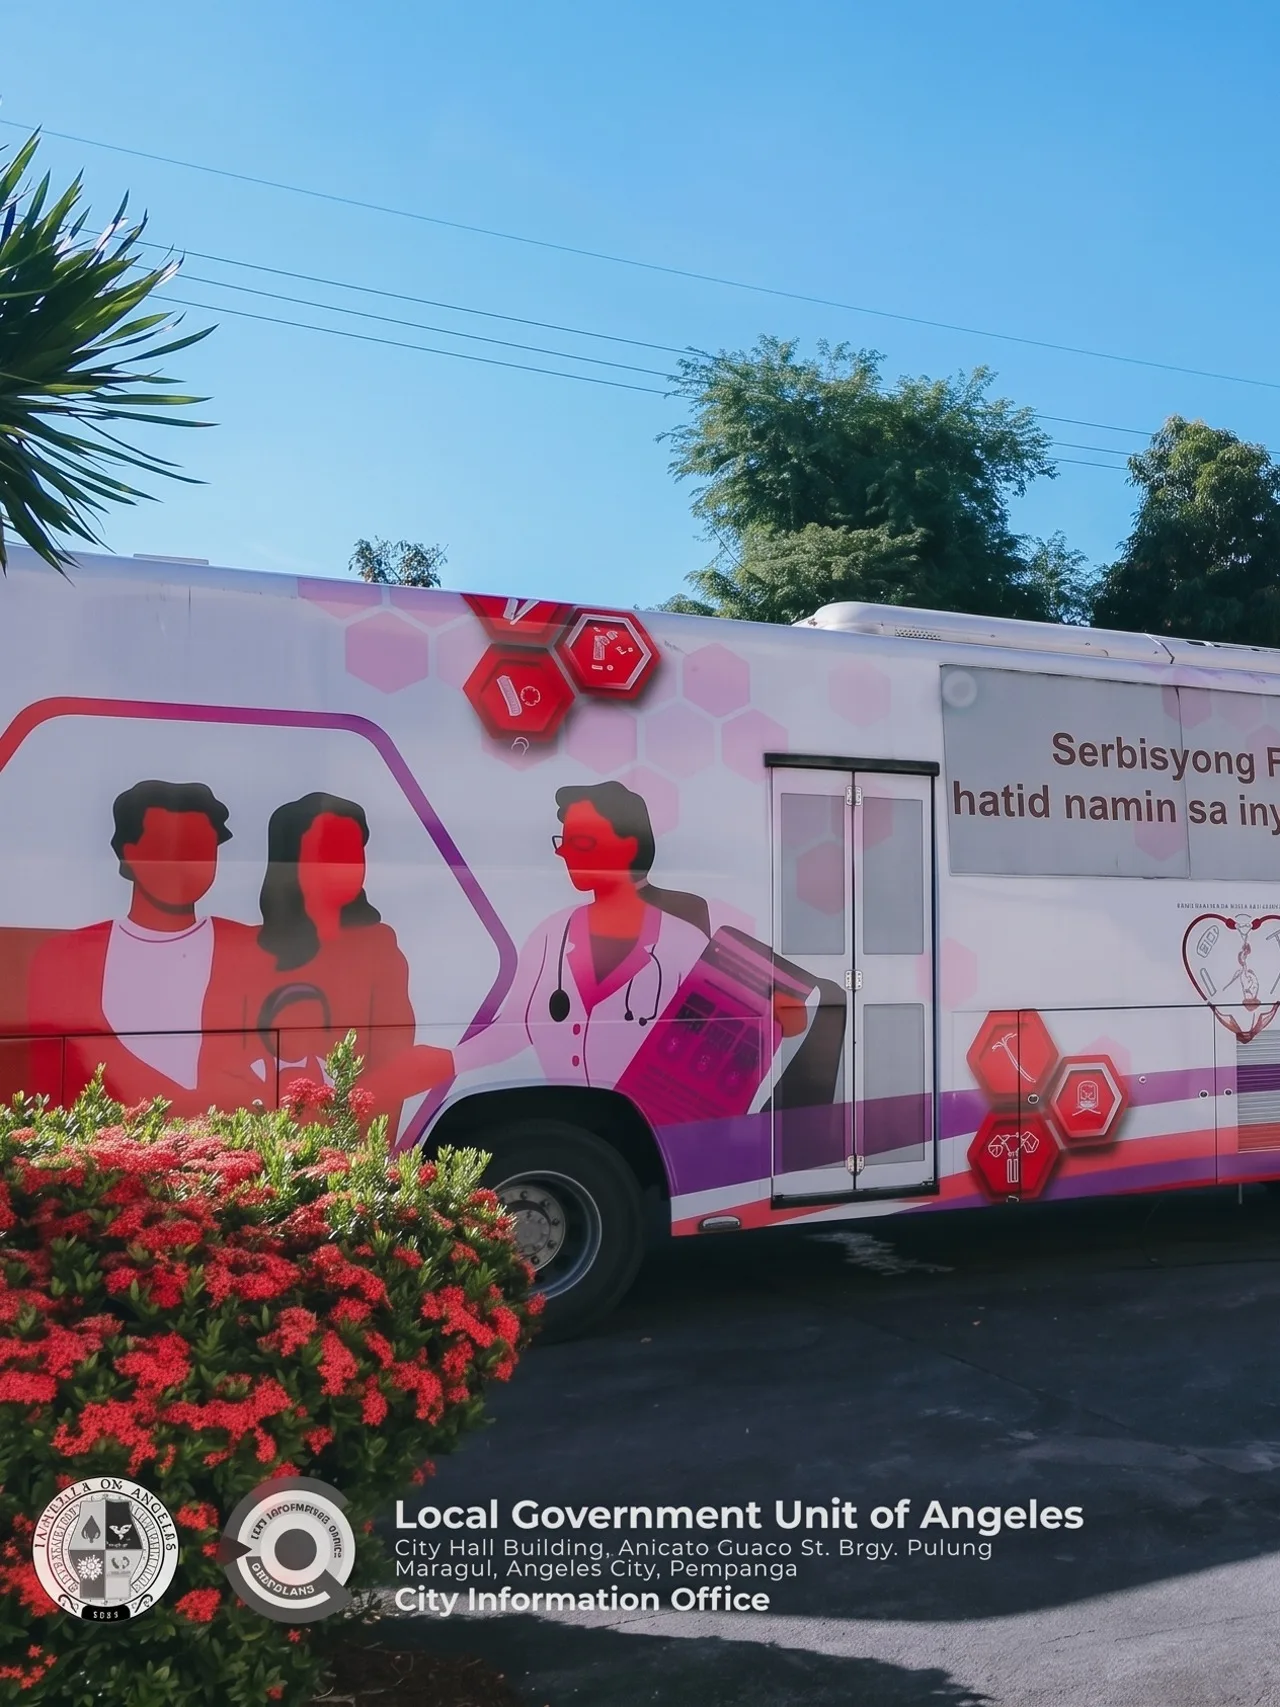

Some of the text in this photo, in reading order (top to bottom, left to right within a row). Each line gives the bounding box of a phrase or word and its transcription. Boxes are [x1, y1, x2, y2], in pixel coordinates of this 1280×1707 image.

[1052, 732, 1255, 784] Serbisyong
[953, 780, 1050, 817] hatid
[1064, 790, 1176, 823] namin
[1189, 799, 1227, 825] sa
